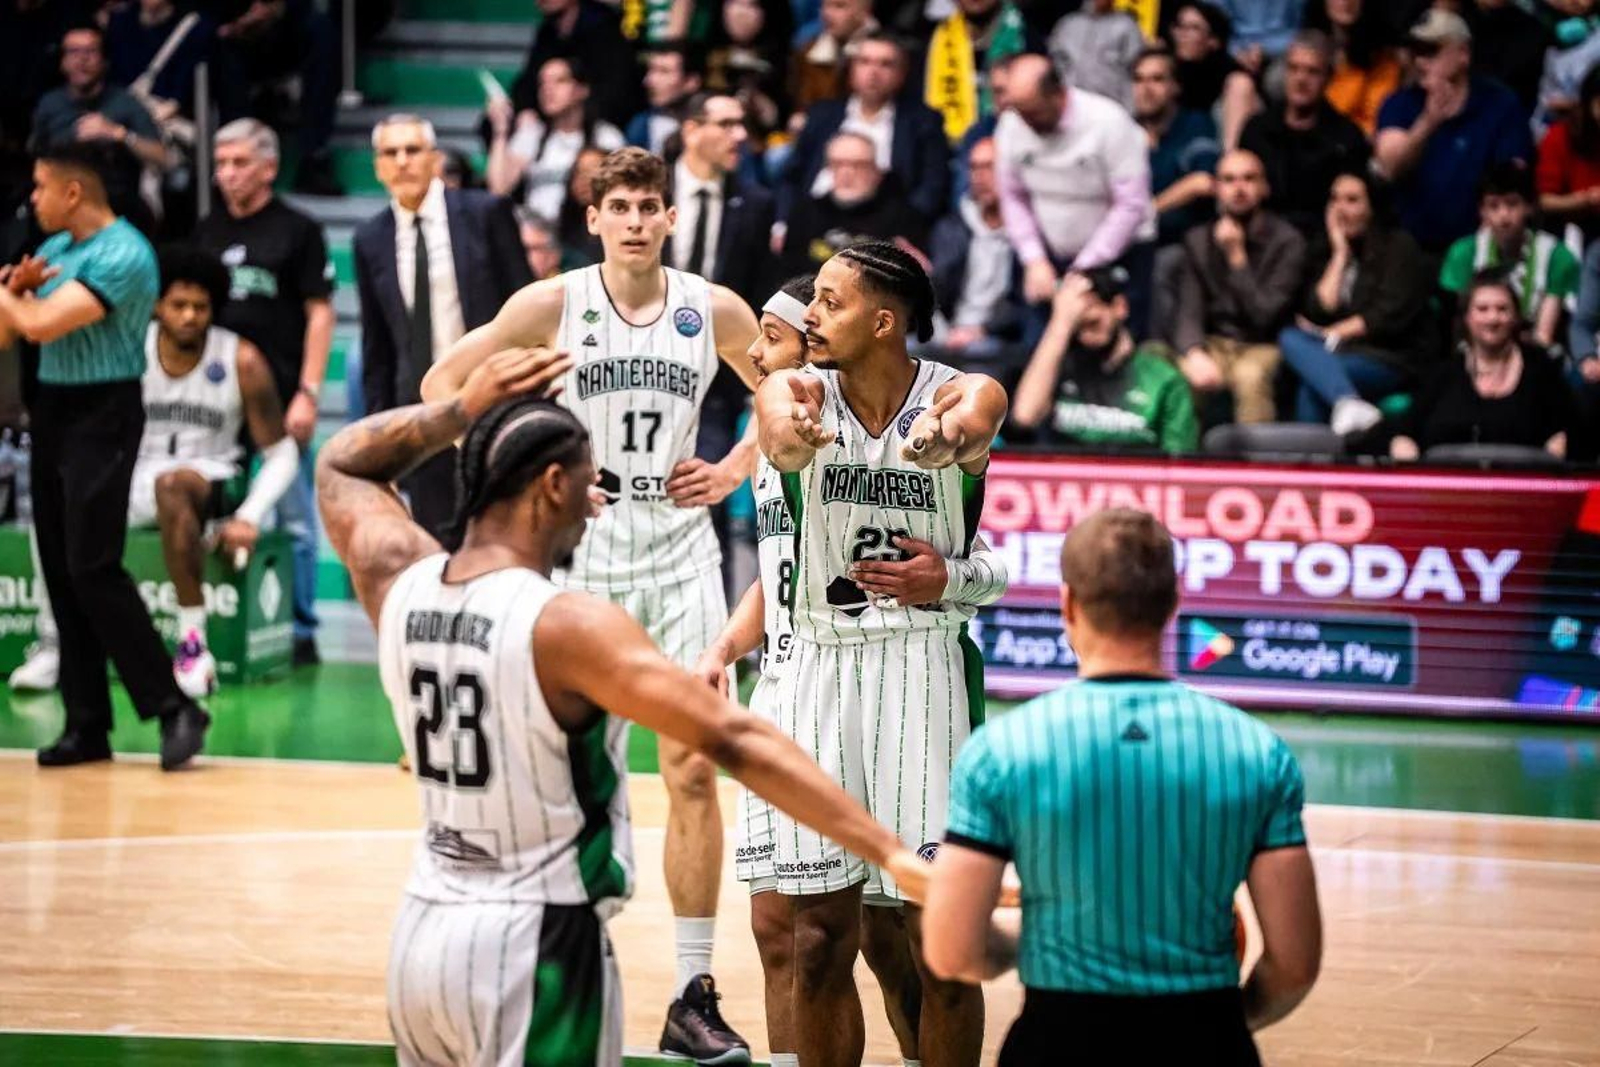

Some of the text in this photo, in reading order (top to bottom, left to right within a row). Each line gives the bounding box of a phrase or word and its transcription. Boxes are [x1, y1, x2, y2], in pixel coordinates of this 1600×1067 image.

[621, 411, 663, 452] 17
[631, 476, 665, 491] GT
[778, 560, 794, 607] 8
[1244, 540, 1523, 604] TODAY
[993, 629, 1057, 668] App
[1243, 638, 1401, 683] Google Play
[410, 665, 493, 790] 23
